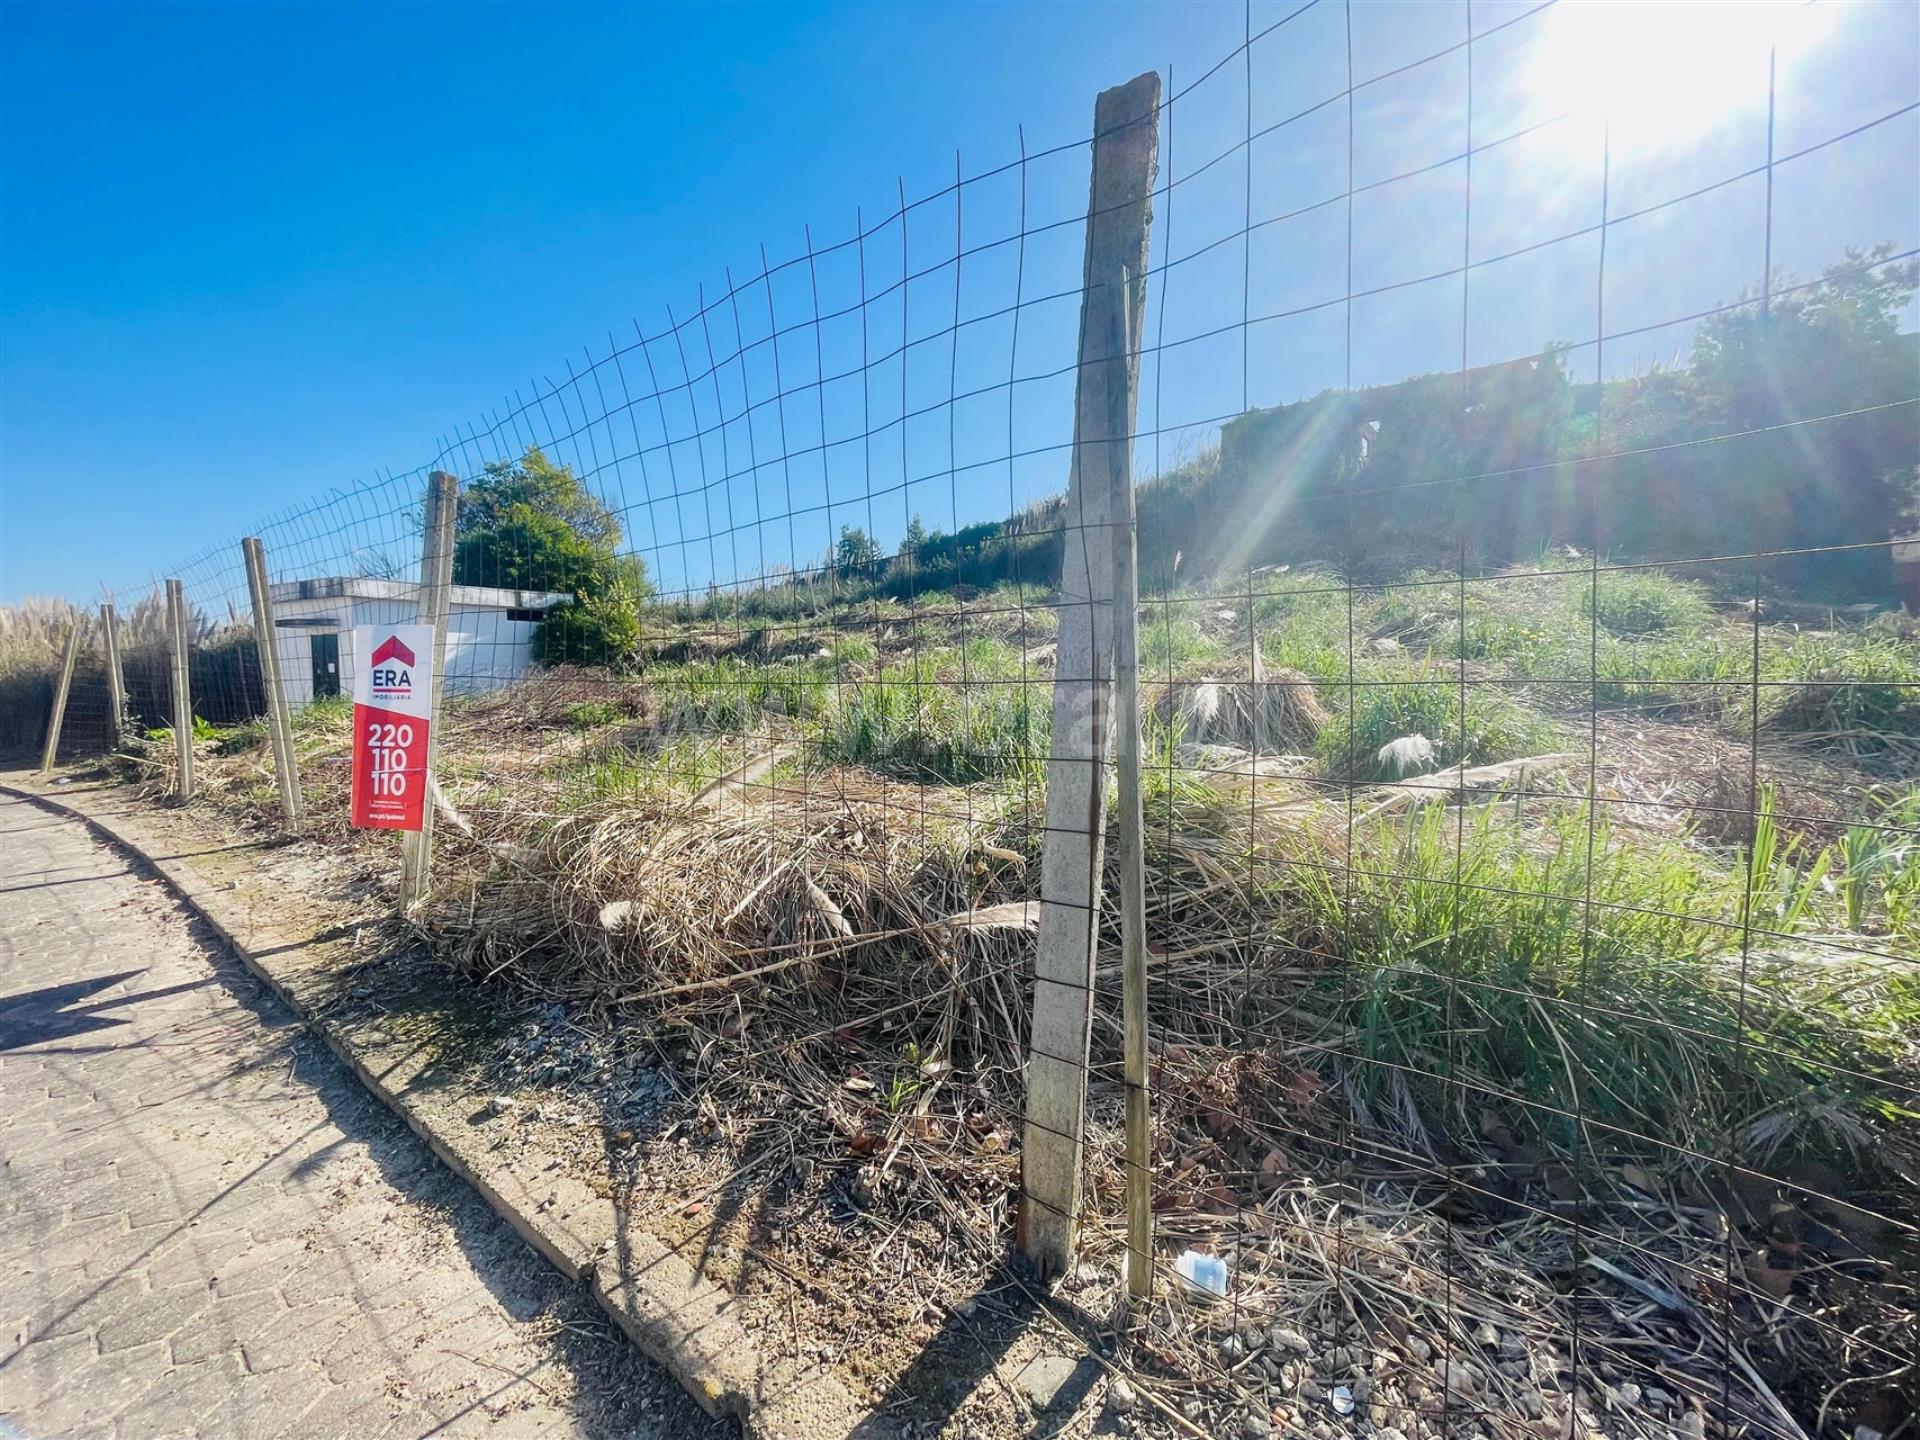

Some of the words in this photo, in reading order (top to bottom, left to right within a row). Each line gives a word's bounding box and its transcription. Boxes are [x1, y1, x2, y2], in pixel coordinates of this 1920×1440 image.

[373, 670, 412, 687] ERA
[368, 723, 413, 748] 220
[372, 748, 407, 772] 110
[371, 772, 406, 796] 110
